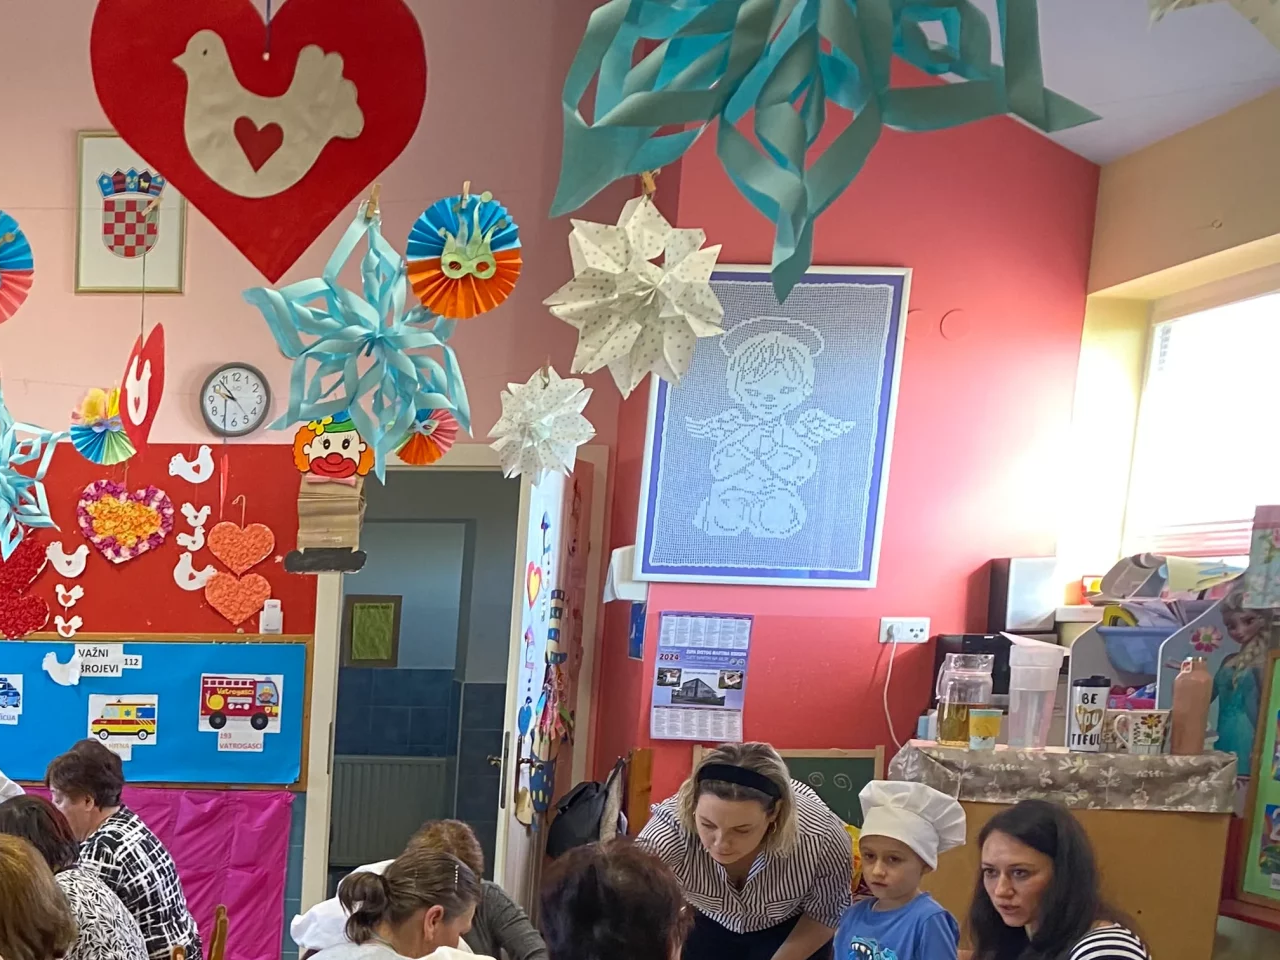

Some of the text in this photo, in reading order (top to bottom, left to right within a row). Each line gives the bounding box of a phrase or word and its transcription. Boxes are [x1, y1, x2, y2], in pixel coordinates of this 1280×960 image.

[232, 372, 242, 382] 12
[252, 383, 259, 393] 2
[208, 395, 214, 404] 9
[256, 395, 262, 404] 3
[212, 406, 218, 416] 8
[251, 407, 256, 415] 4
[231, 418, 238, 427] 6
[243, 415, 249, 424] 5
[78, 646, 109, 658] VAŽNI
[659, 653, 680, 661] 2024
[1082, 693, 1098, 704] BE
[219, 742, 262, 750] VATROGASCI
